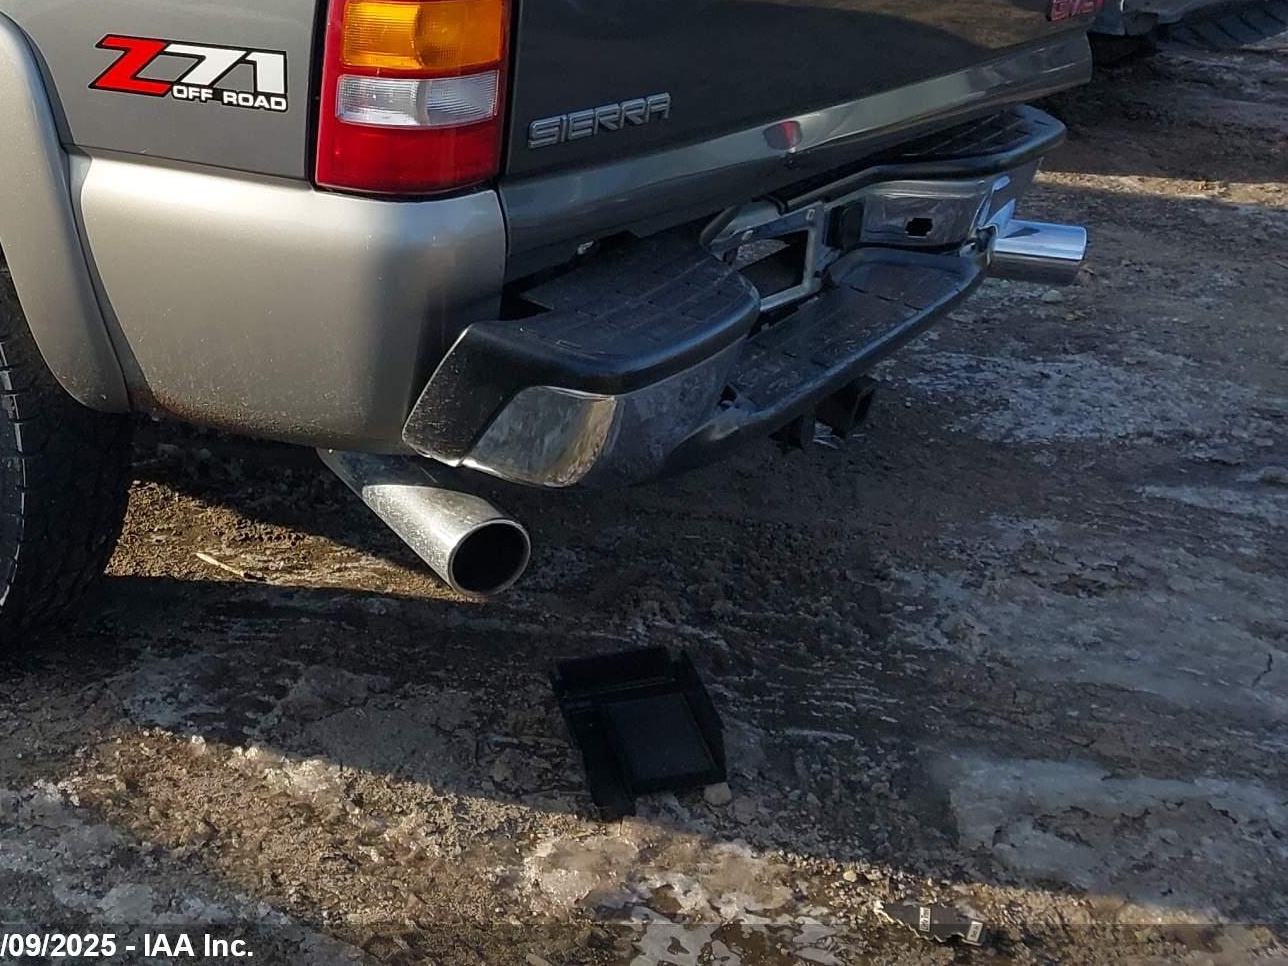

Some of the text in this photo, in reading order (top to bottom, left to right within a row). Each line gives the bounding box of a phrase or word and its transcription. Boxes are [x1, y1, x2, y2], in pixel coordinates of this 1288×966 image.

[89, 34, 287, 97] Z71
[171, 85, 287, 112] OFF ROAD
[528, 92, 671, 149] SIERRA
